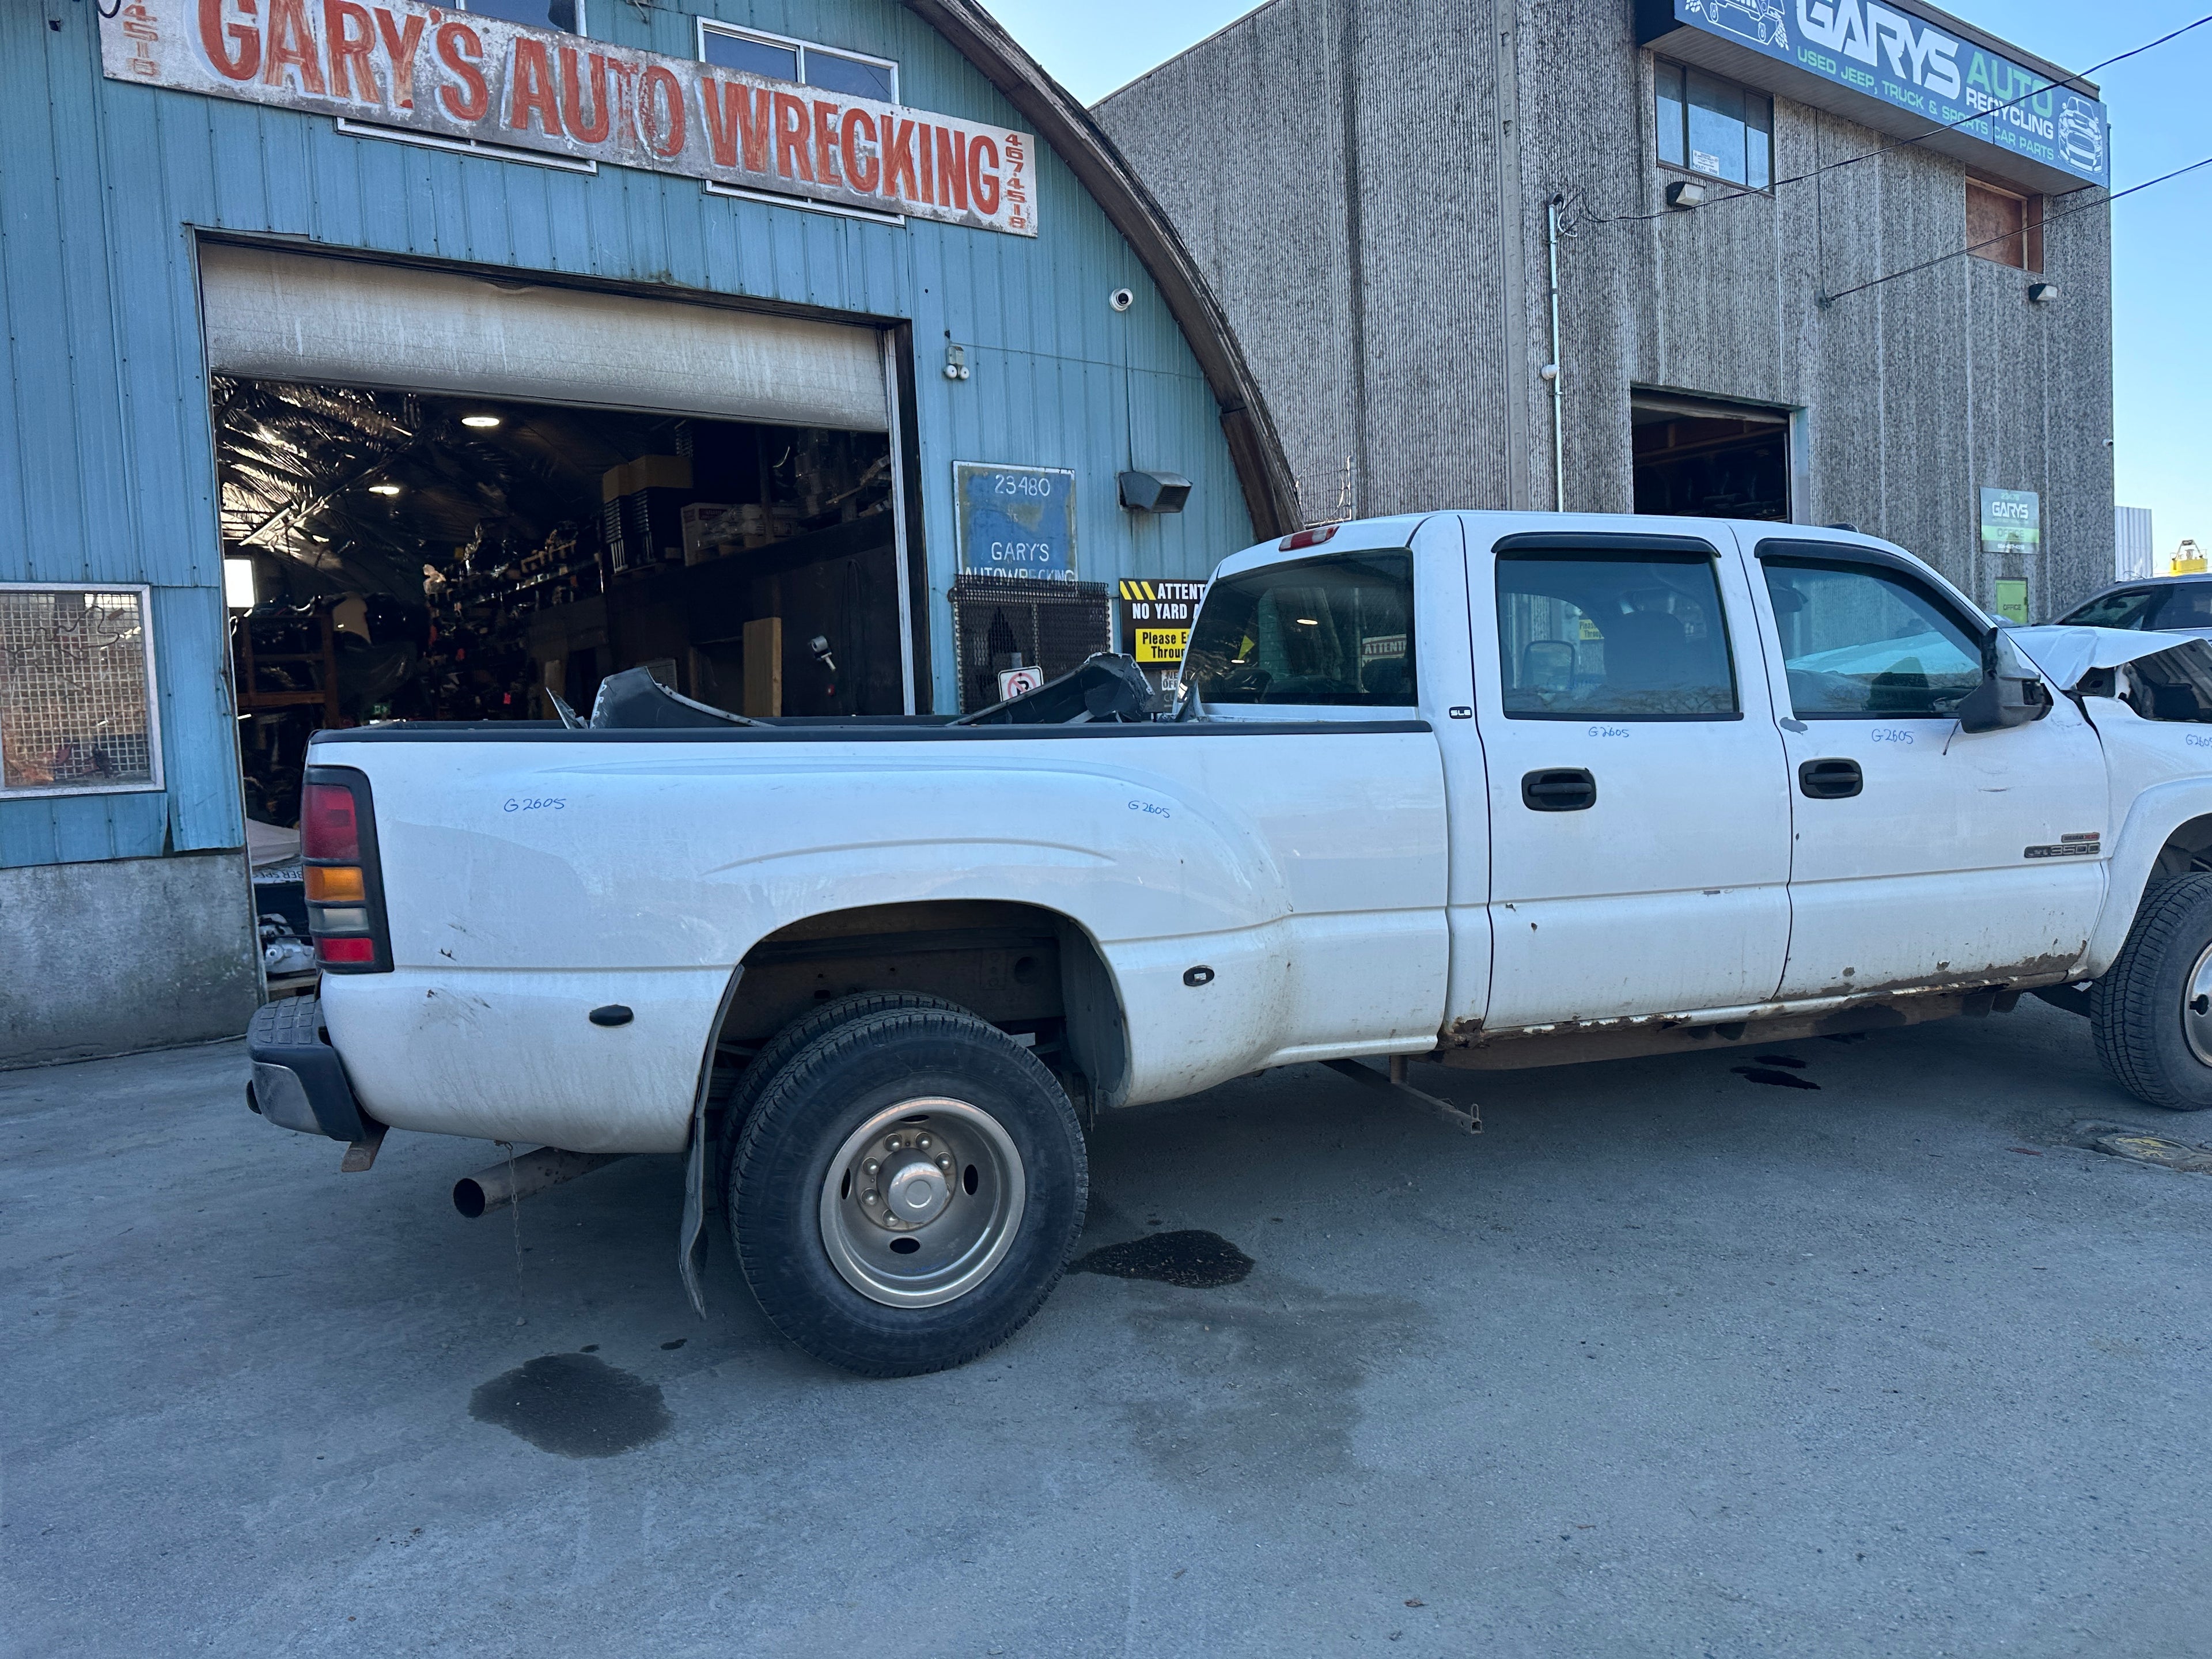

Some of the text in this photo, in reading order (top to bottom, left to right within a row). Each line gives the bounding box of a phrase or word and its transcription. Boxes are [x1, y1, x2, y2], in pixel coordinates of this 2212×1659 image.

[1796, 0, 1961, 100] GARYS
[1966, 51, 2052, 118] AUTO
[198, 0, 999, 215] GARY'S AUTO WRECKING
[1797, 46, 2054, 161] USED JEEP, TRUCK & SPORTS CAR PARTS
[1966, 87, 2054, 139] RECYCLING
[995, 474, 1051, 496] 23480
[1993, 501, 2029, 519] GARYS
[1997, 528, 2025, 538] OFFICE
[991, 542, 1049, 562] GARY'S
[1157, 583, 1208, 600] ATTENT
[1132, 603, 1150, 619] NO
[1155, 603, 1187, 619] YARD
[1142, 632, 1176, 645] Please
[2051, 844, 2100, 855] 3500
